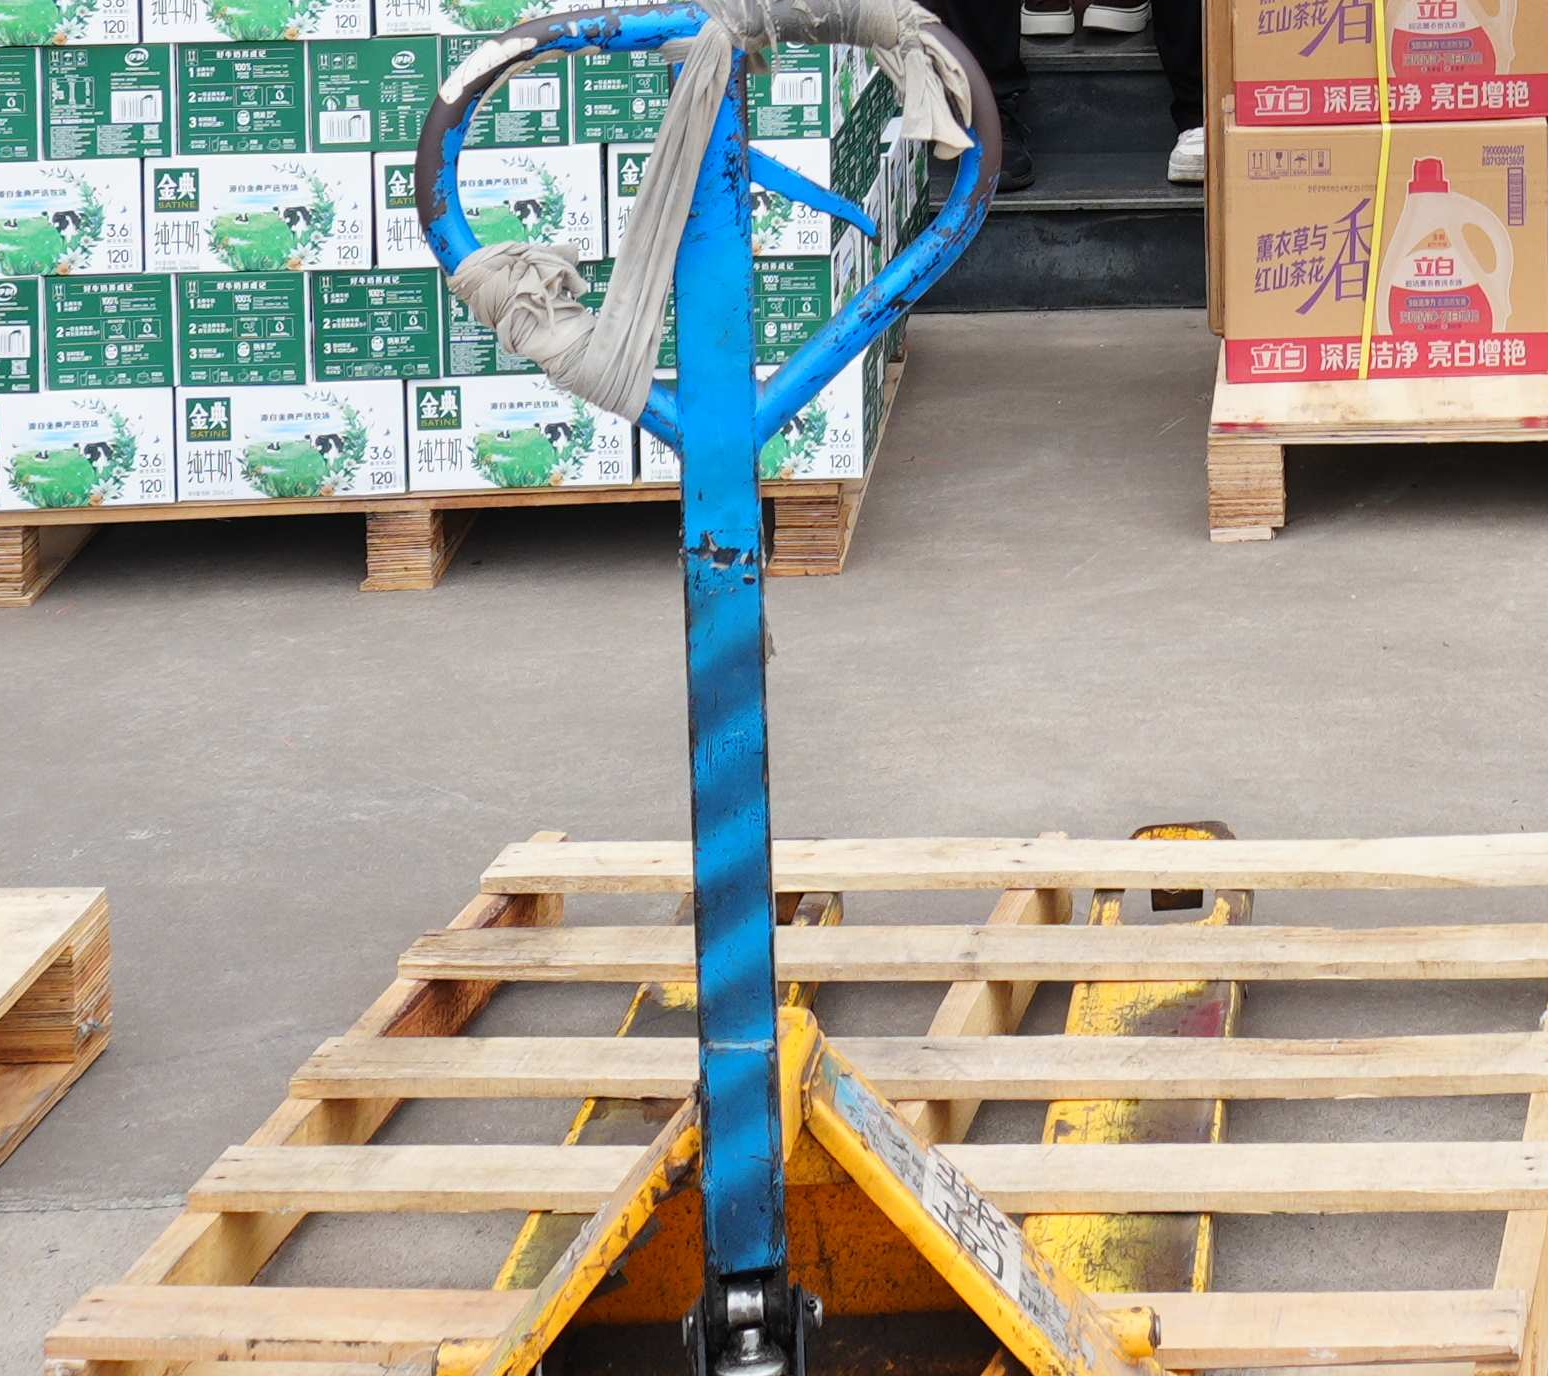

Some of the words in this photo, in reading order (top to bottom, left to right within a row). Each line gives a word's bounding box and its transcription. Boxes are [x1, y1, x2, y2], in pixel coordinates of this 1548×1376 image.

[1257, 0, 1329, 36] 红山茶花
[1417, 0, 1458, 20] 立白
[1255, 85, 1310, 116] 立白
[1430, 80, 1530, 110] 亮白增艳
[158, 172, 197, 200] 金典
[155, 221, 201, 257] 纯牛奶
[337, 219, 359, 234] 3.6
[338, 245, 359, 260] 120
[1256, 224, 1328, 263] 薰衣草与
[1295, 198, 1374, 315] 香
[1254, 256, 1326, 294] 红山茶花
[1413, 256, 1455, 277] 立白
[1251, 343, 1307, 374] 立白
[1320, 341, 1419, 371] 深层洁净
[1428, 339, 1527, 368] 亮白增艳
[190, 402, 229, 430] 金典
[421, 391, 460, 419] 金典
[370, 446, 393, 460] 3.6
[598, 435, 619, 449] 3.6
[139, 454, 162, 468] 3.6
[187, 451, 233, 487] 纯牛奶
[418, 440, 464, 476] 纯牛奶
[599, 461, 620, 475] 120
[140, 479, 162, 494] 120
[370, 471, 393, 485] 120
